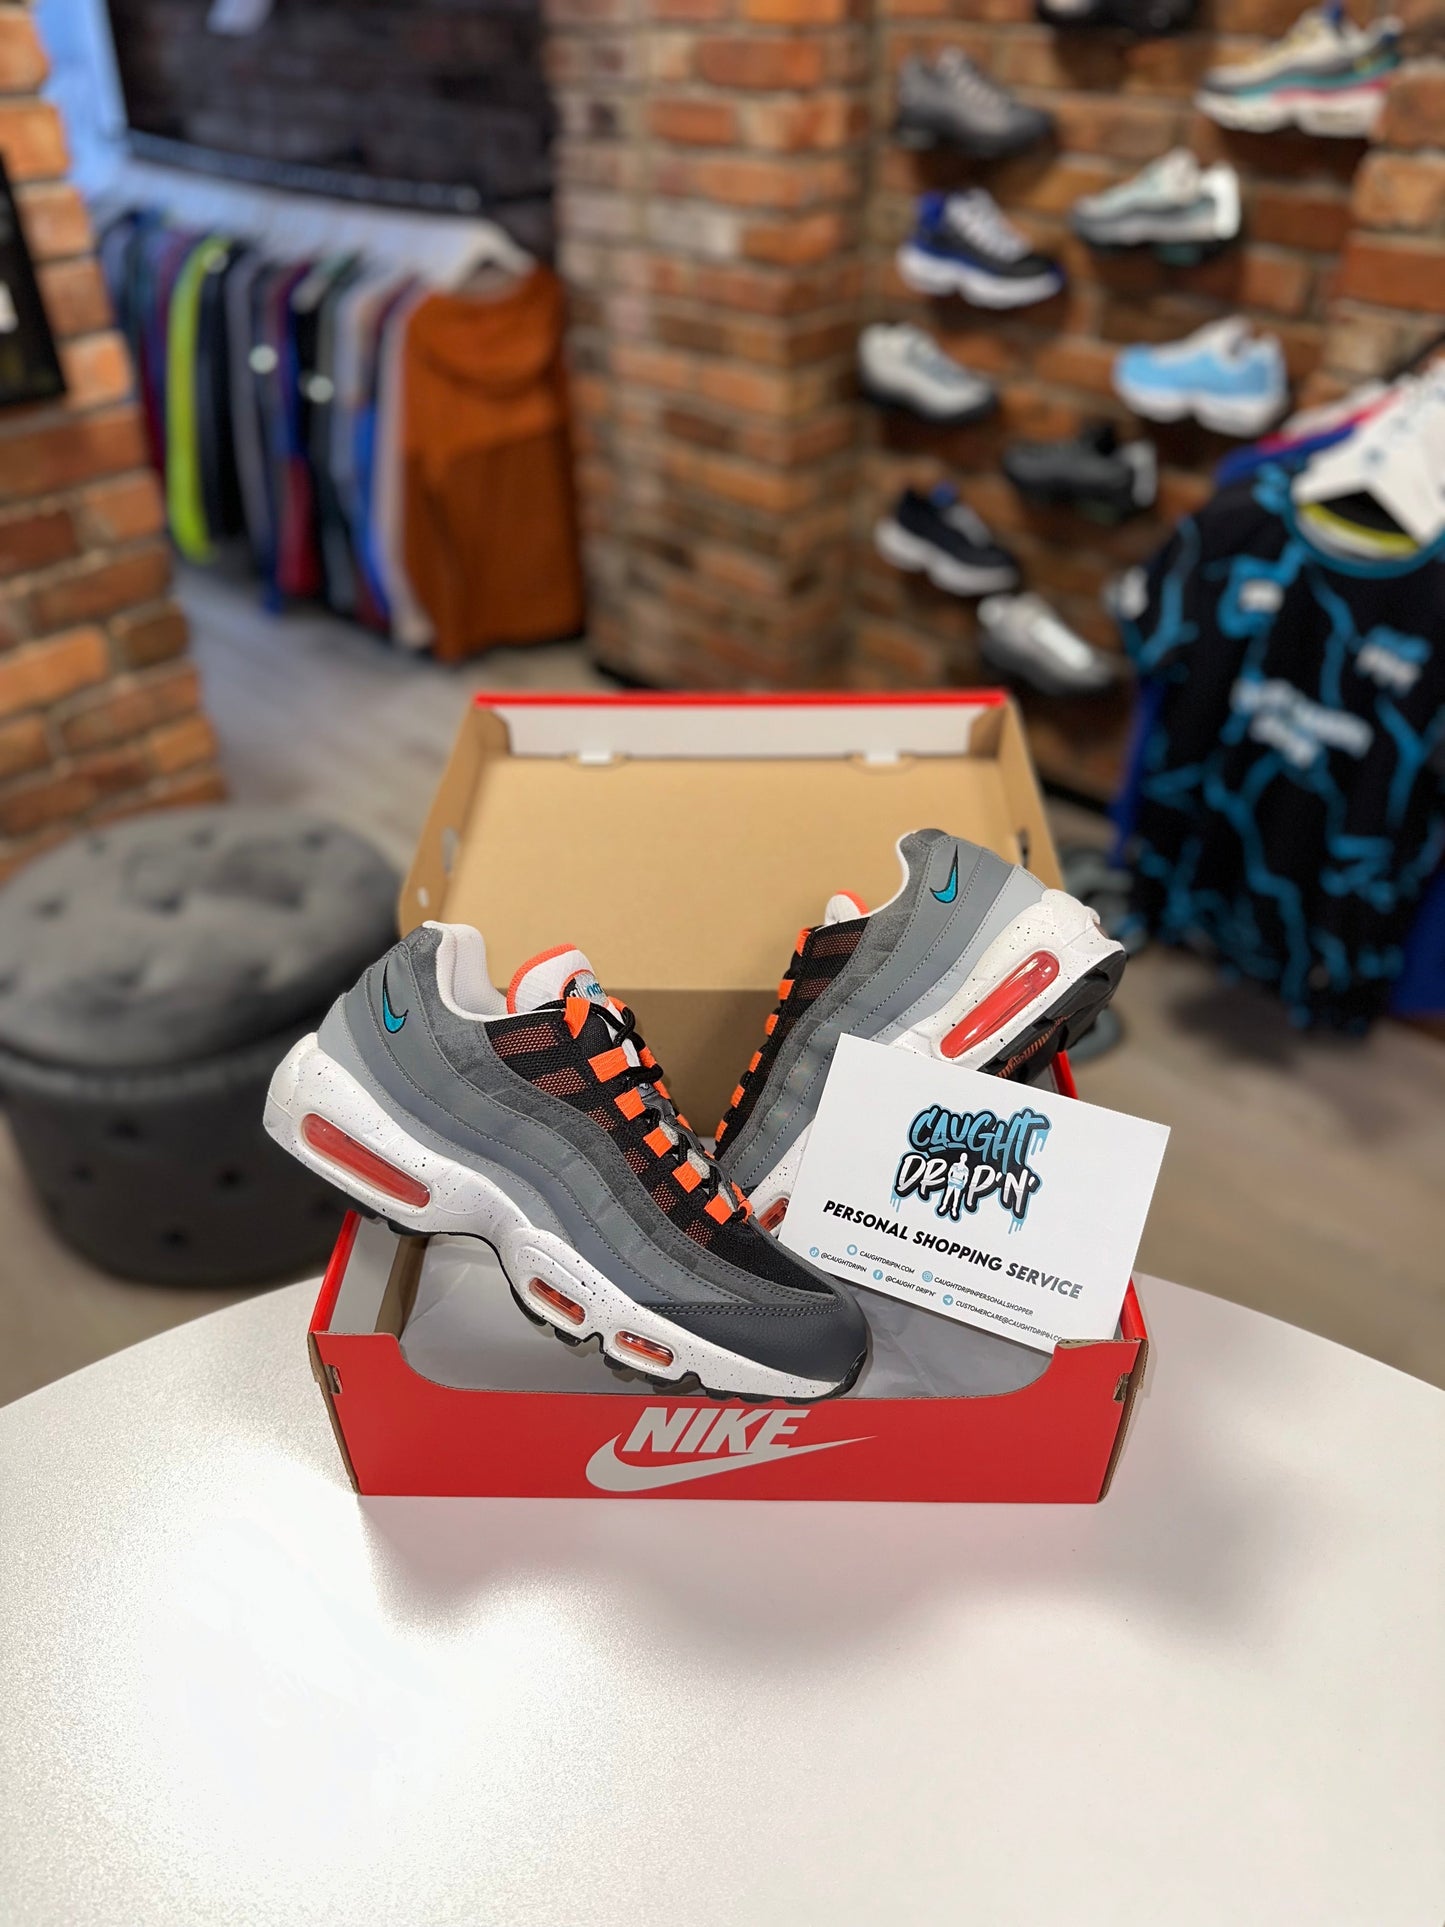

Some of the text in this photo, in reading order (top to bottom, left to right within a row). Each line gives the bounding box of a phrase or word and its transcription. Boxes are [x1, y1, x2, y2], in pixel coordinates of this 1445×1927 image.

[909, 1104, 1050, 1174] CAUGHT
[820, 1252, 868, 1273] @CAUGHTDRIPIN
[822, 1199, 1084, 1300] PERSONAL SHOPPING SERVICE
[859, 1250, 915, 1274] CAUGHTDRIPIN.COM
[885, 1275, 915, 1290] @CAUGHT
[934, 1276, 1034, 1317] CAUGHTDRIPINPERSONALSHOPPER
[621, 1406, 811, 1453] NIKE
